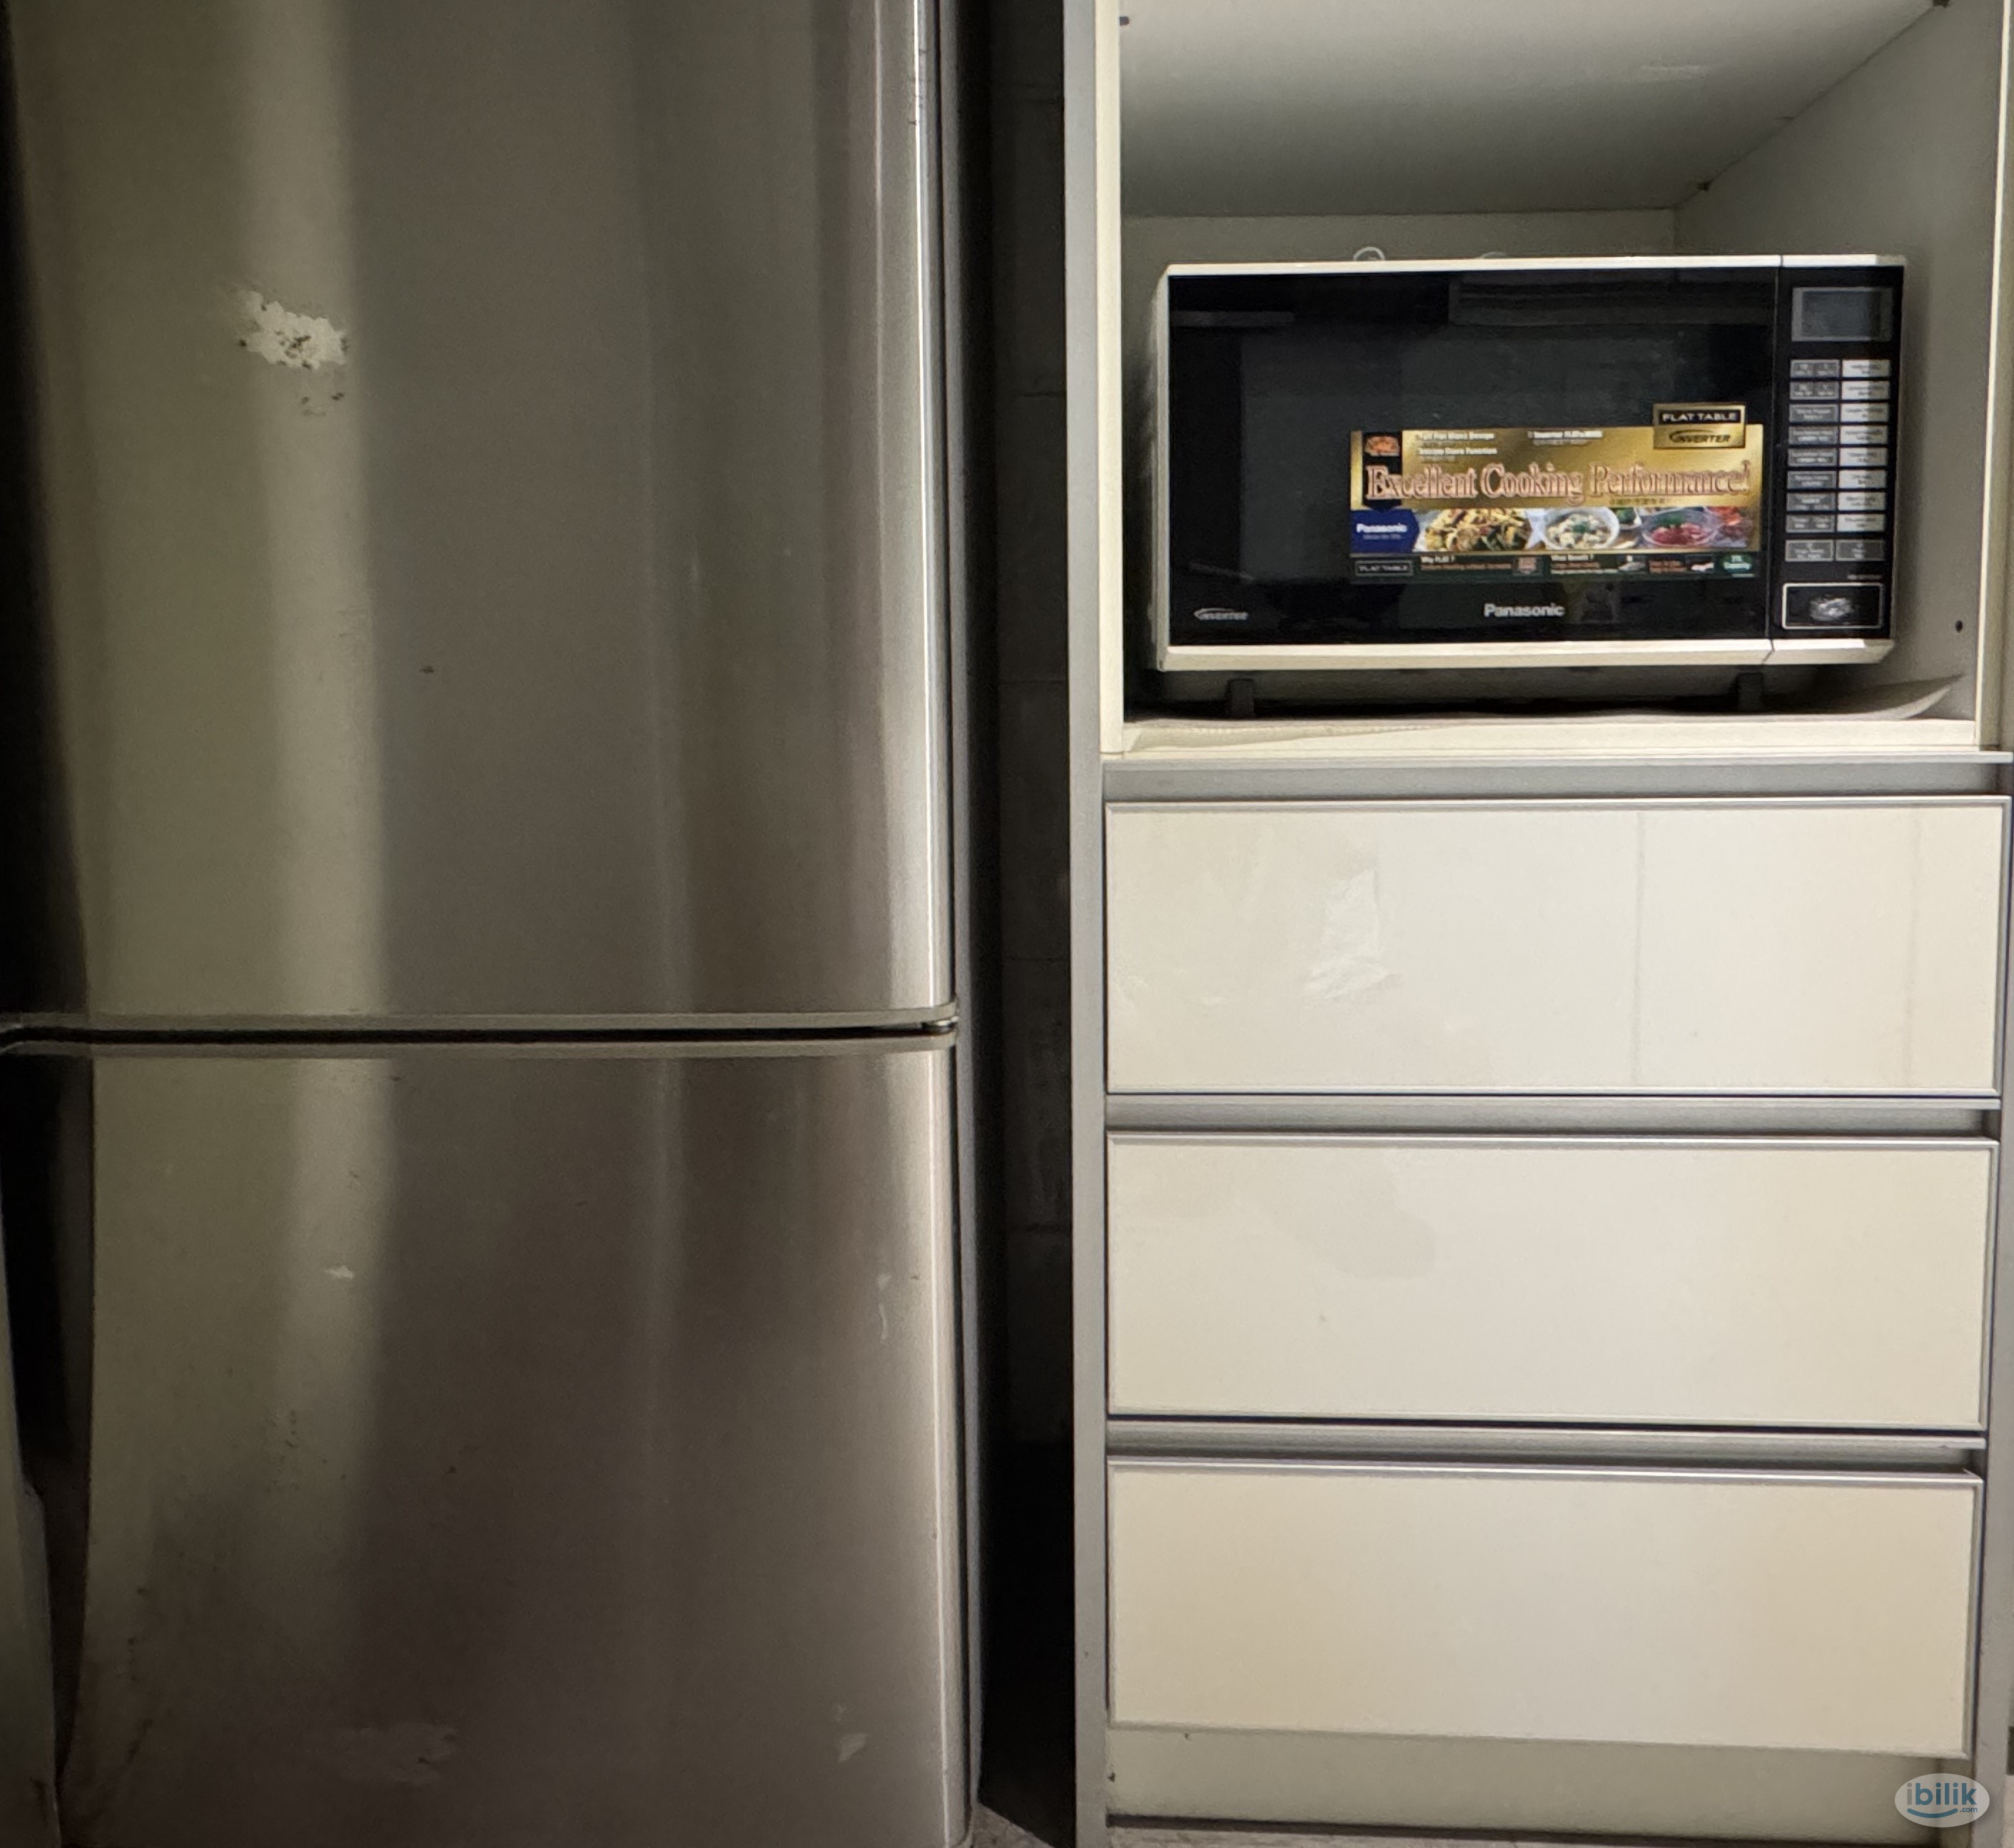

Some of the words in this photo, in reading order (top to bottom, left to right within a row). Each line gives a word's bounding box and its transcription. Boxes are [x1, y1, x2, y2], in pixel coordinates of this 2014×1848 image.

[1661, 412, 1693, 422] FLAT
[1697, 412, 1739, 422] TABLE
[1669, 429, 1731, 443] INVERTER
[1365, 464, 1478, 499] Excellent
[1480, 462, 1584, 505] Cooking
[1589, 460, 1752, 497] Performance!
[1484, 602, 1566, 617] Panasonic
